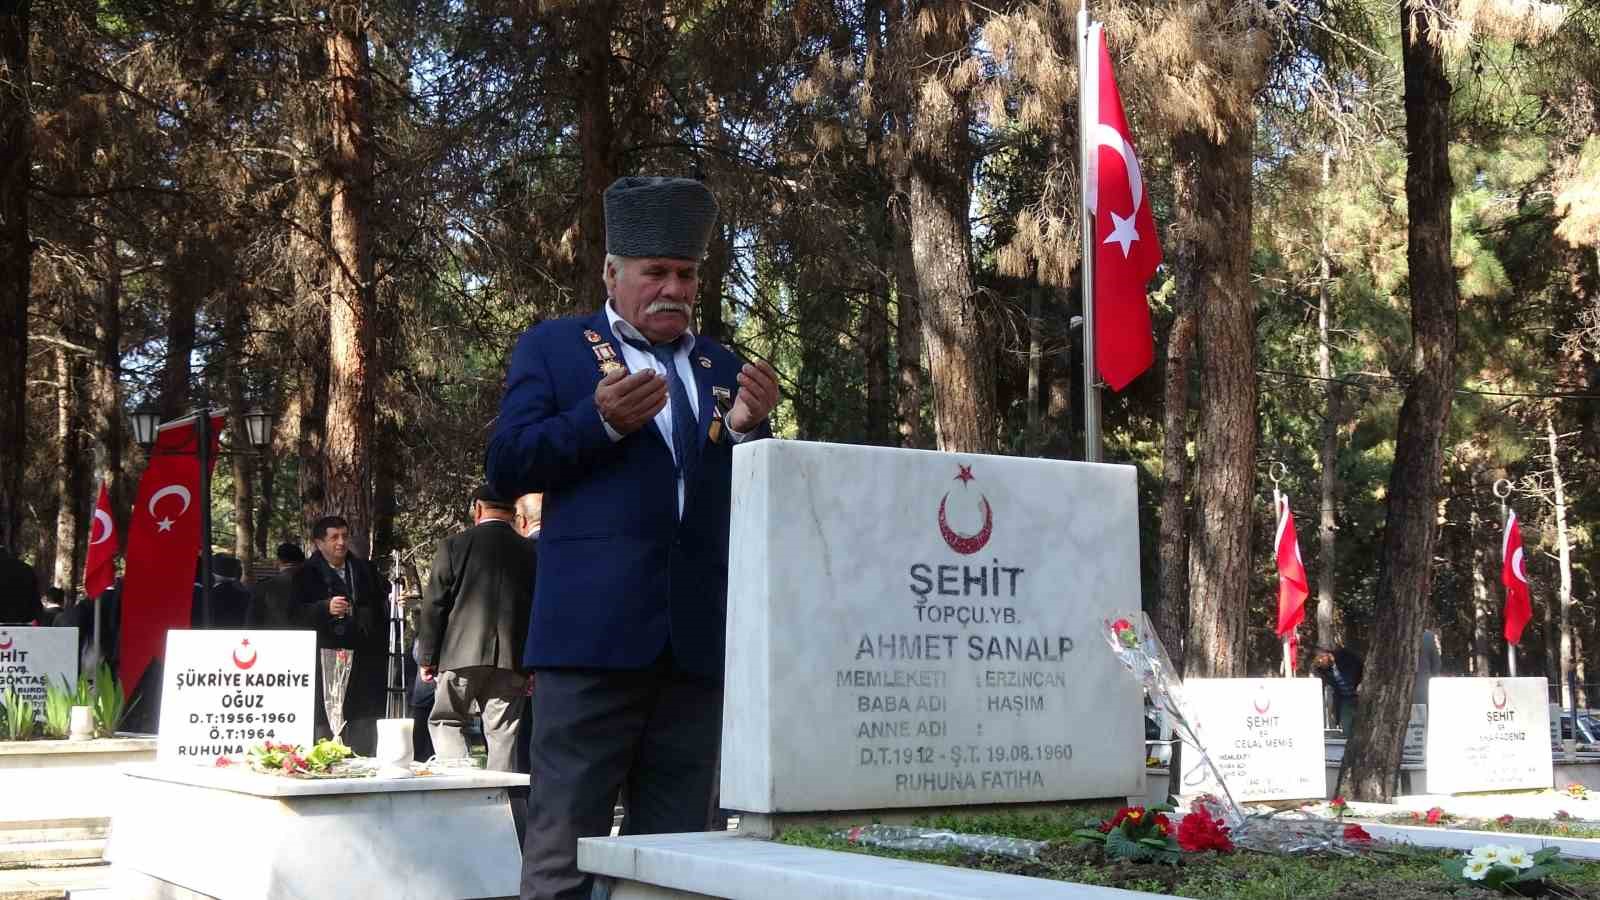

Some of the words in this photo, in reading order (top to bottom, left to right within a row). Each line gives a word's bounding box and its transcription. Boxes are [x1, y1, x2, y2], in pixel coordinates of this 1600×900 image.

[909, 558, 1024, 605] ŞEHİT
[913, 605, 1022, 628] TOPÇU.YB.
[0, 648, 29, 663] HİT
[855, 632, 959, 661] AHMET
[967, 635, 1074, 662] SANALP
[176, 668, 242, 690] ŞÜKRİYE
[245, 669, 310, 688] KADRİYE
[221, 689, 265, 709] OĞUZ
[857, 696, 912, 712] BABA
[916, 696, 948, 712] ADI
[857, 720, 912, 738] ANNE
[916, 720, 948, 736] ADI
[178, 745, 244, 757] RUHUNA
[895, 771, 977, 792] RUHUNA
